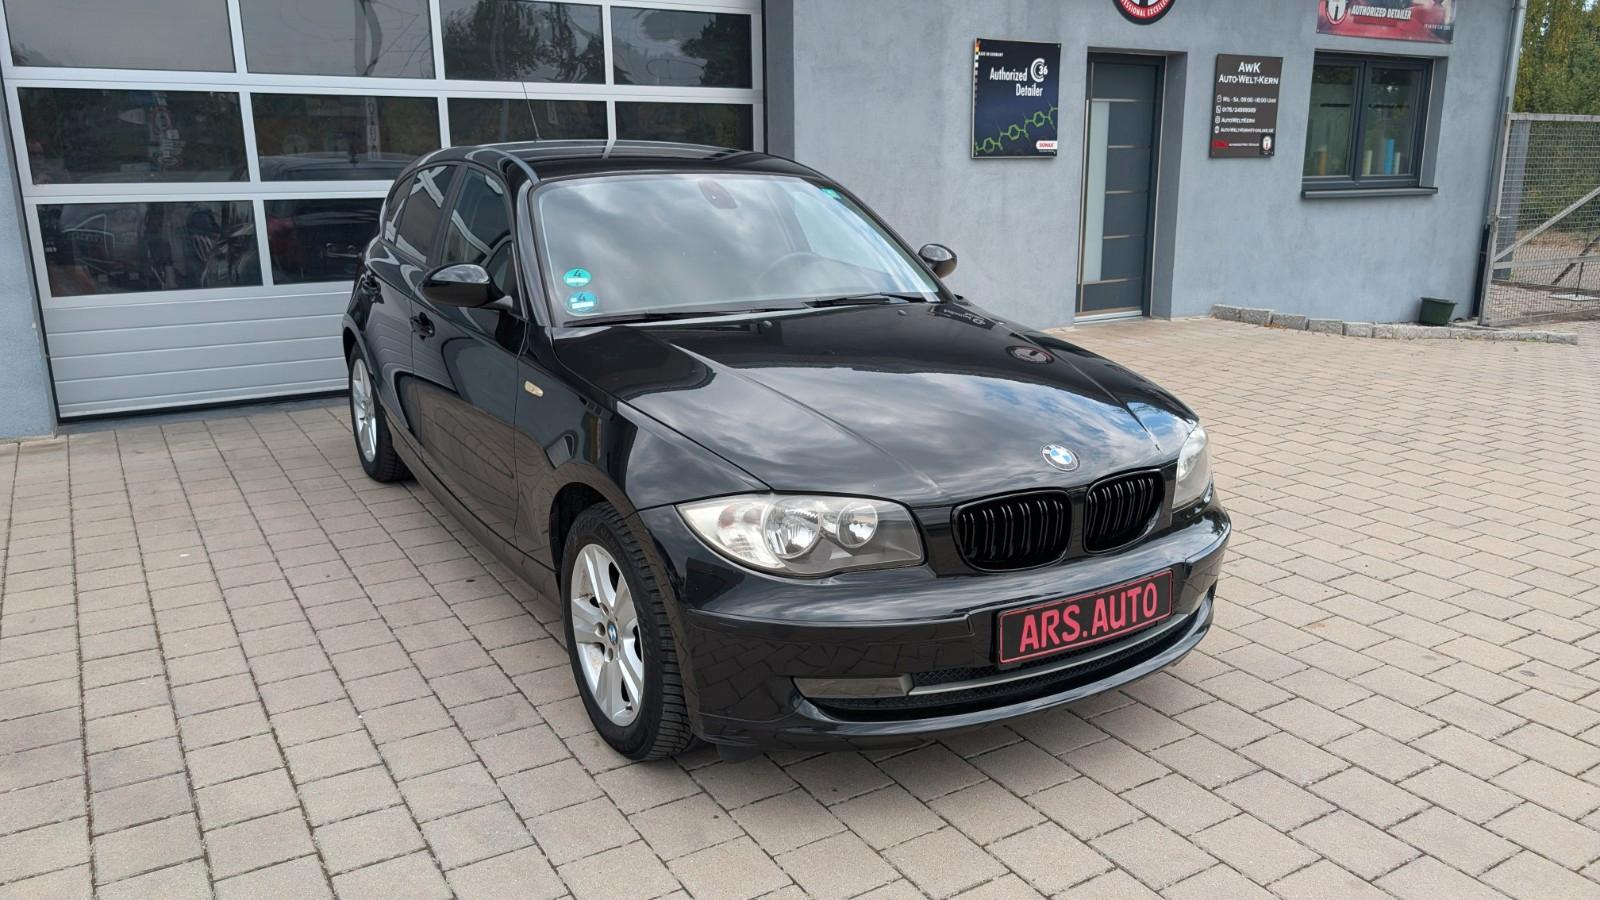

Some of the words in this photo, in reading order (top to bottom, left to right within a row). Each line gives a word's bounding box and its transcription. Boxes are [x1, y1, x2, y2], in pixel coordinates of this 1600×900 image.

[1351, 5, 1387, 17] AUTHORIZED
[1387, 8, 1412, 20] DETAILER
[989, 66, 1028, 81] Authorized
[1015, 83, 1043, 97] Detailer
[1019, 582, 1158, 653] ARS.AUTO
